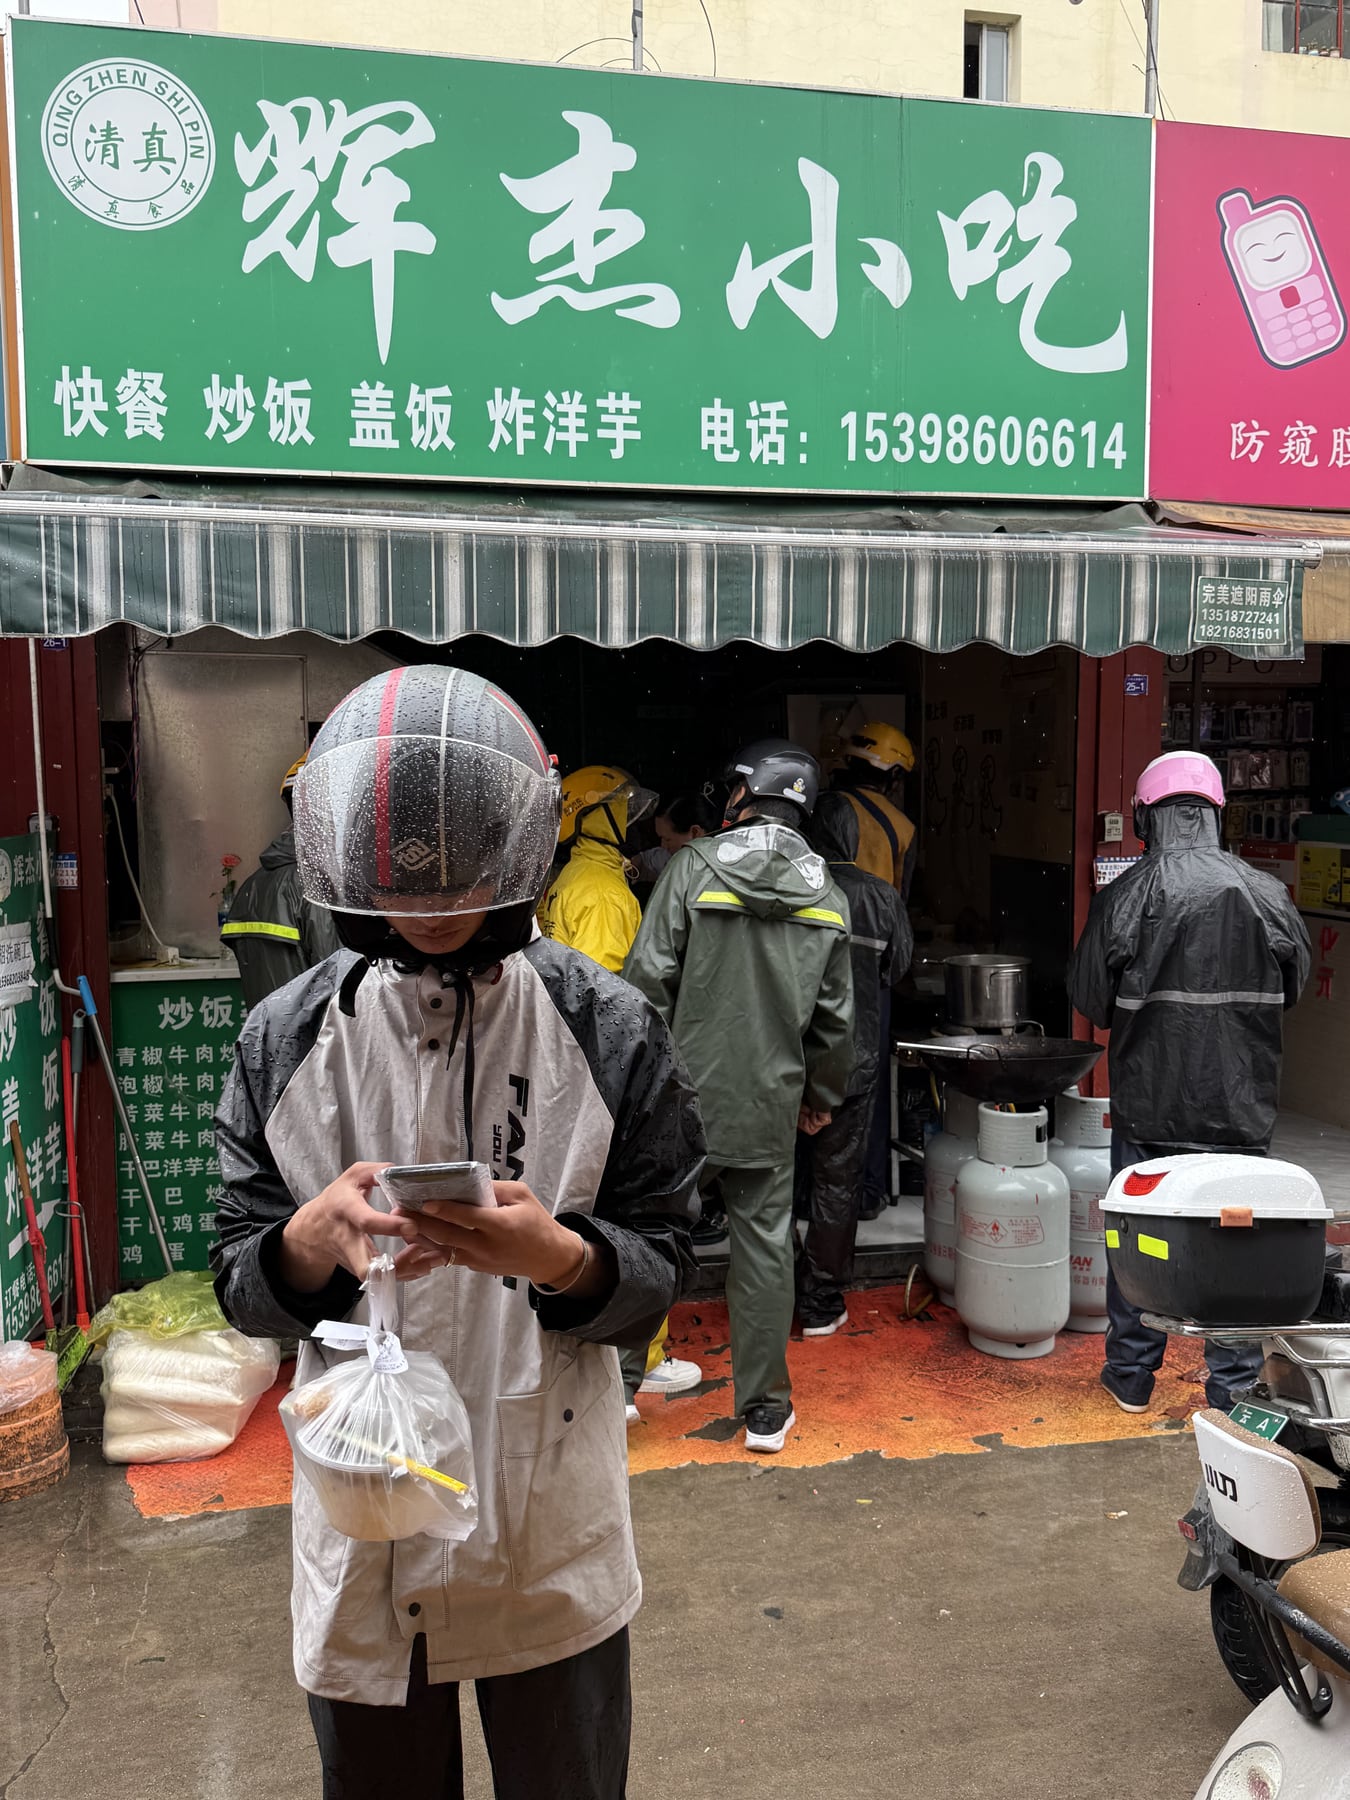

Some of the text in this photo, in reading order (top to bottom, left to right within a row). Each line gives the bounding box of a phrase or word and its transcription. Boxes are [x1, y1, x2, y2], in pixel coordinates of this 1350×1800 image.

[52, 68, 205, 160] QING ZHEN SHI PIN
[85, 120, 177, 175] 清真
[68, 175, 195, 219] 清真食品
[234, 97, 1127, 373] 辉杰小吃
[53, 365, 1127, 470] 快餐 炒饭 盖饭 炸洋芋 电话： 15398606614
[1201, 608, 1280, 625] 13518727241
[1202, 583, 1284, 608] 完美遮阳雨伞
[1200, 624, 1280, 640] 18216831501
[1126, 682, 1145, 692] 25-1
